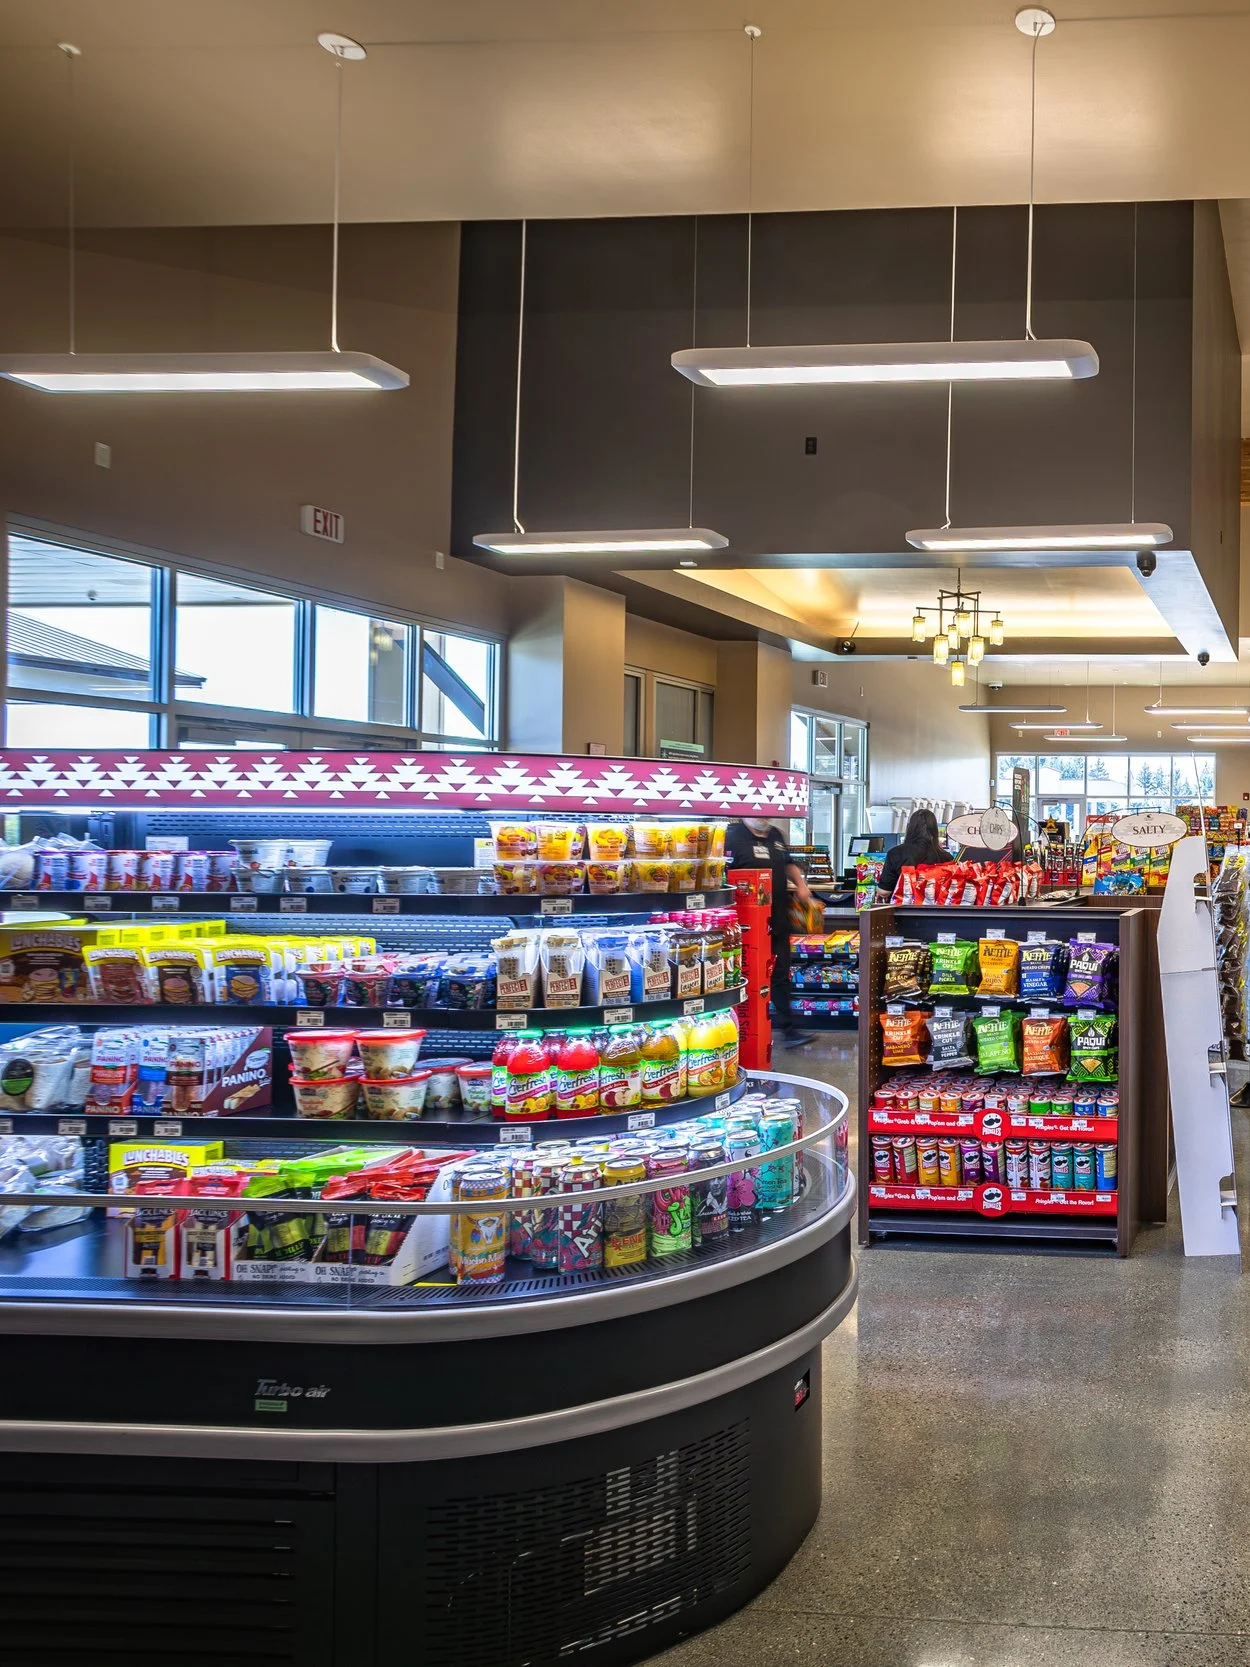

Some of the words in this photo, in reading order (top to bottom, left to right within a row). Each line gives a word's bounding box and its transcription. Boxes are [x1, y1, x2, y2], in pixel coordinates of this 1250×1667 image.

[313, 507, 340, 540] EXIT
[989, 823, 1003, 835] CHIPS
[1132, 825, 1166, 835] SALTY
[11, 932, 81, 951] LUNCHABLES
[222, 1069, 266, 1087] PANINO
[643, 1061, 679, 1082] Everfresh
[508, 1075, 547, 1096] Everfresh
[559, 1070, 596, 1093] Everfresh
[85, 1105, 120, 1114] PANINO
[982, 1127, 1001, 1137] PRINGLES
[123, 1148, 190, 1166] LUNCHABLES
[983, 1201, 1001, 1210] PRINGLES
[236, 1264, 248, 1274] OH
[315, 1266, 327, 1275] OH
[254, 1379, 303, 1397] Turbo
[305, 1384, 331, 1398] air
